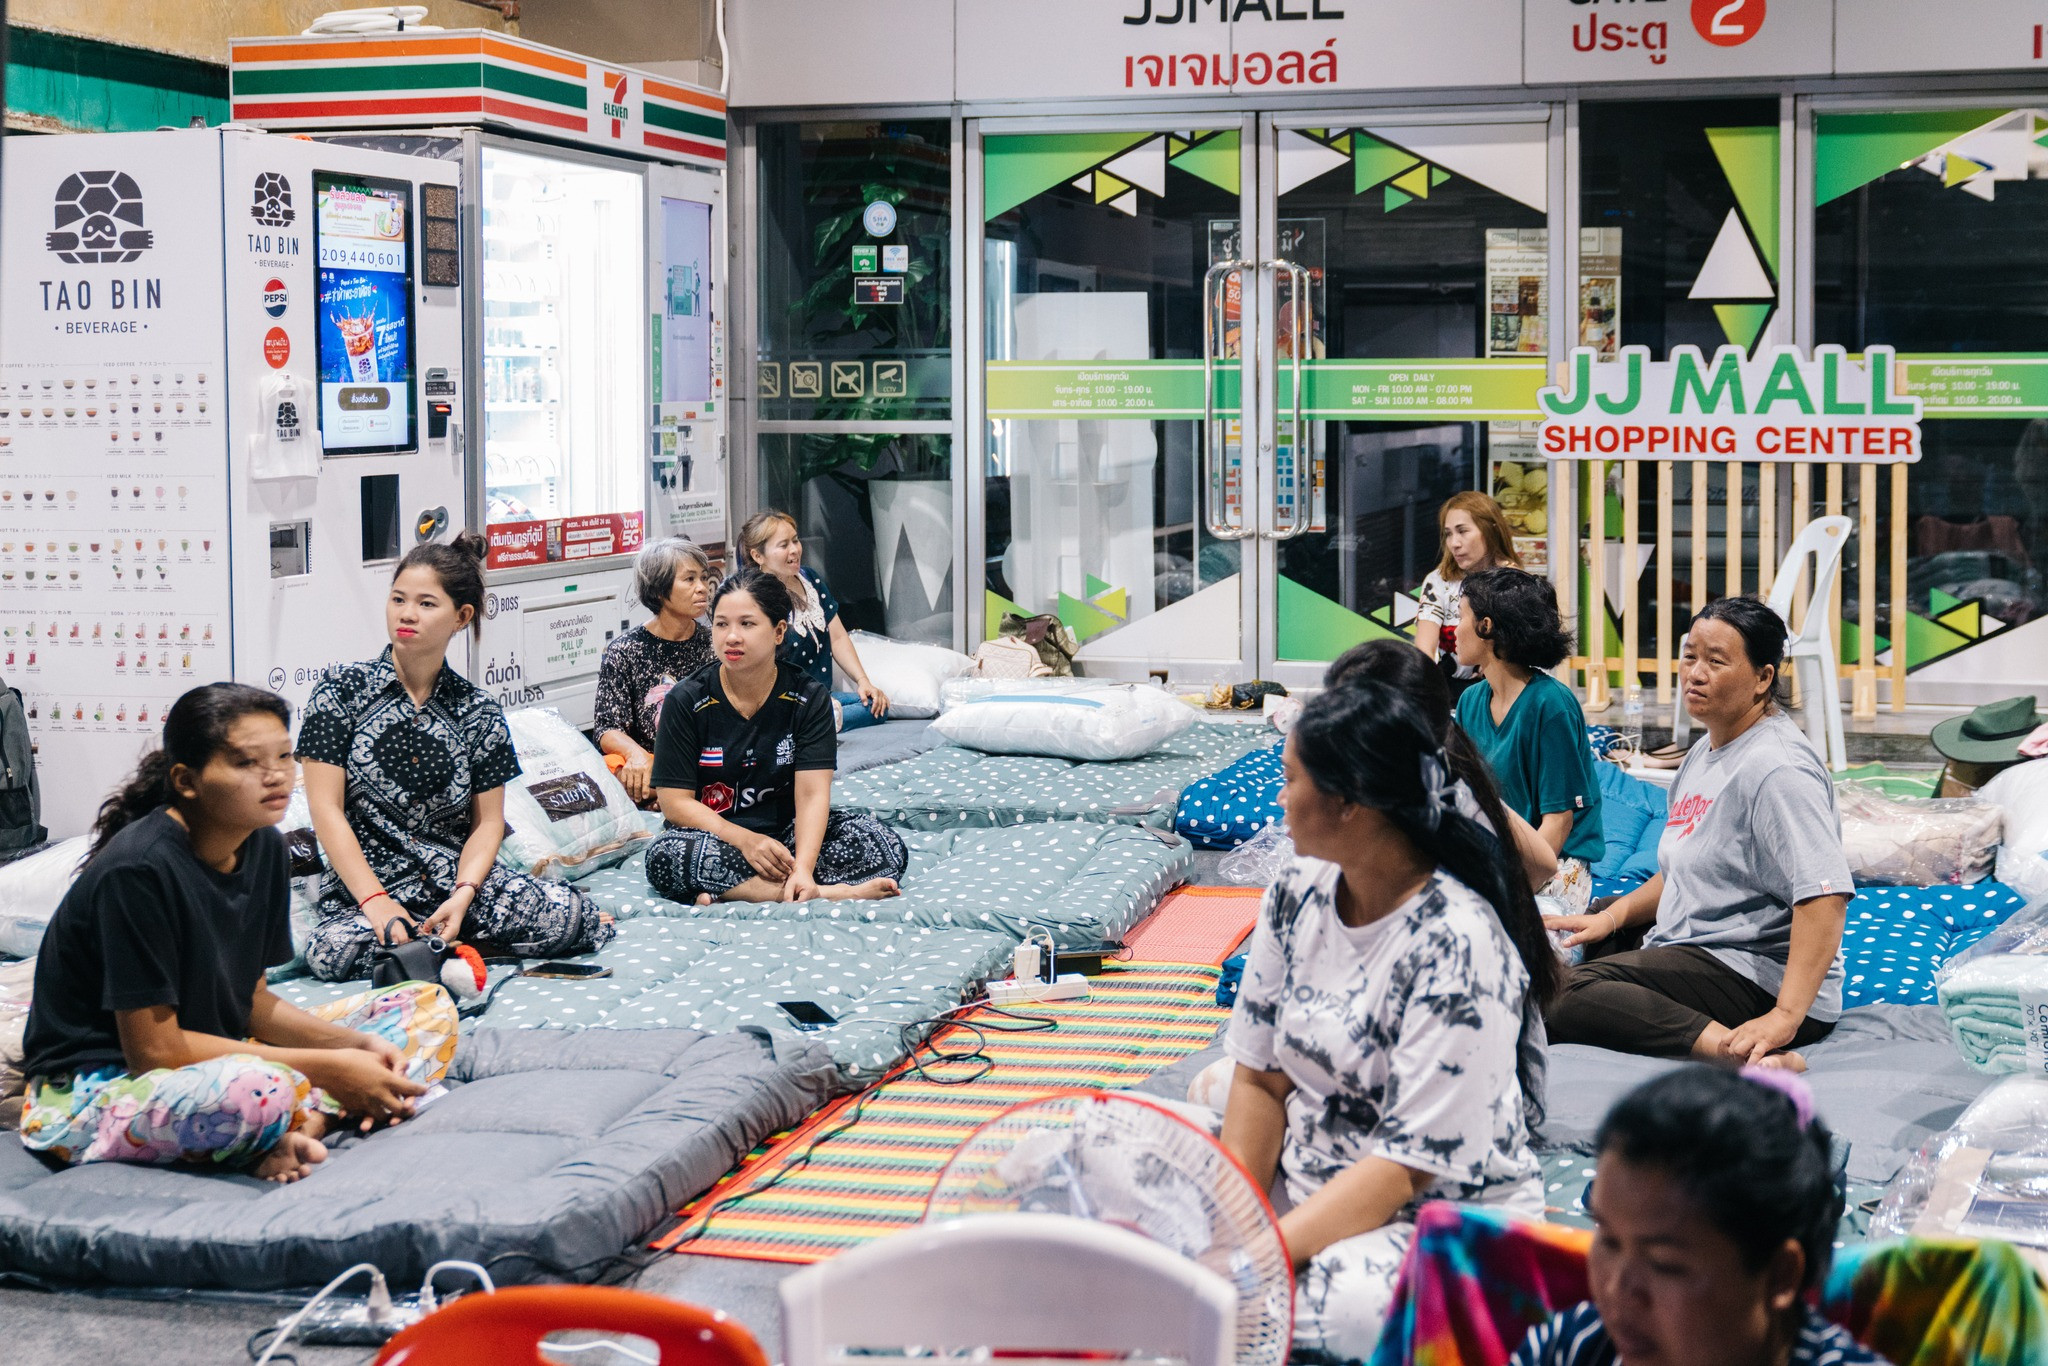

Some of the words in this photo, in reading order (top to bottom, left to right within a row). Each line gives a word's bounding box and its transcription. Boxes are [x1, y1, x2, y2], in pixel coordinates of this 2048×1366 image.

[1710, 0, 1746, 36] 2
[1572, 12, 1668, 65] ประตู
[1125, 37, 1338, 88] เจเจมอลล์
[248, 233, 272, 254] TAO
[278, 236, 299, 255] BIN
[259, 259, 289, 269] BEVERAGE
[322, 248, 401, 267] 209,440,601
[39, 280, 91, 311] TAO
[111, 277, 162, 310] BIN
[264, 294, 287, 303] PEPSI
[65, 321, 138, 335] BEVERAGE
[1389, 373, 1409, 382] OPEN
[1413, 373, 1434, 382] DAILY
[1543, 353, 1641, 415] JJ
[1669, 353, 1915, 415] MALL
[1095, 386, 1115, 394] 10.00
[1123, 386, 1144, 394] 19.00
[1352, 385, 1369, 393] MON
[1378, 385, 1389, 393] FRI
[1392, 385, 1413, 393] 10.00
[1415, 385, 1427, 393] AM
[1436, 385, 1458, 393] 07.00
[1460, 385, 1472, 393] PM
[1952, 381, 1976, 390] 10.00
[1986, 381, 2010, 390] 19.00
[1097, 399, 1117, 407] 10.00
[1125, 399, 1146, 407] 20.00
[1352, 397, 1366, 405] SAT
[1375, 397, 1389, 405] SUN
[1392, 397, 1413, 405] 10.00
[1416, 397, 1428, 405] AM
[1436, 397, 1458, 405] 08.00
[1460, 397, 1472, 405] PM
[1954, 396, 1978, 404] 10.00
[1988, 395, 2012, 404] 20.00
[1544, 426, 1737, 454] SHOPPING
[1756, 426, 1914, 455] CENTER
[624, 518, 639, 530] true
[490, 525, 543, 548] เติมเงินทรูที่ตู้นี้
[622, 529, 639, 546] 5G
[501, 596, 519, 612] BOSS
[550, 613, 593, 630] รอสัญญาณไฟเขียว
[561, 640, 574, 652] PULL
[576, 638, 583, 648] UP
[485, 651, 521, 686] ดื่มด่ำ
[272, 675, 283, 683] LINE
